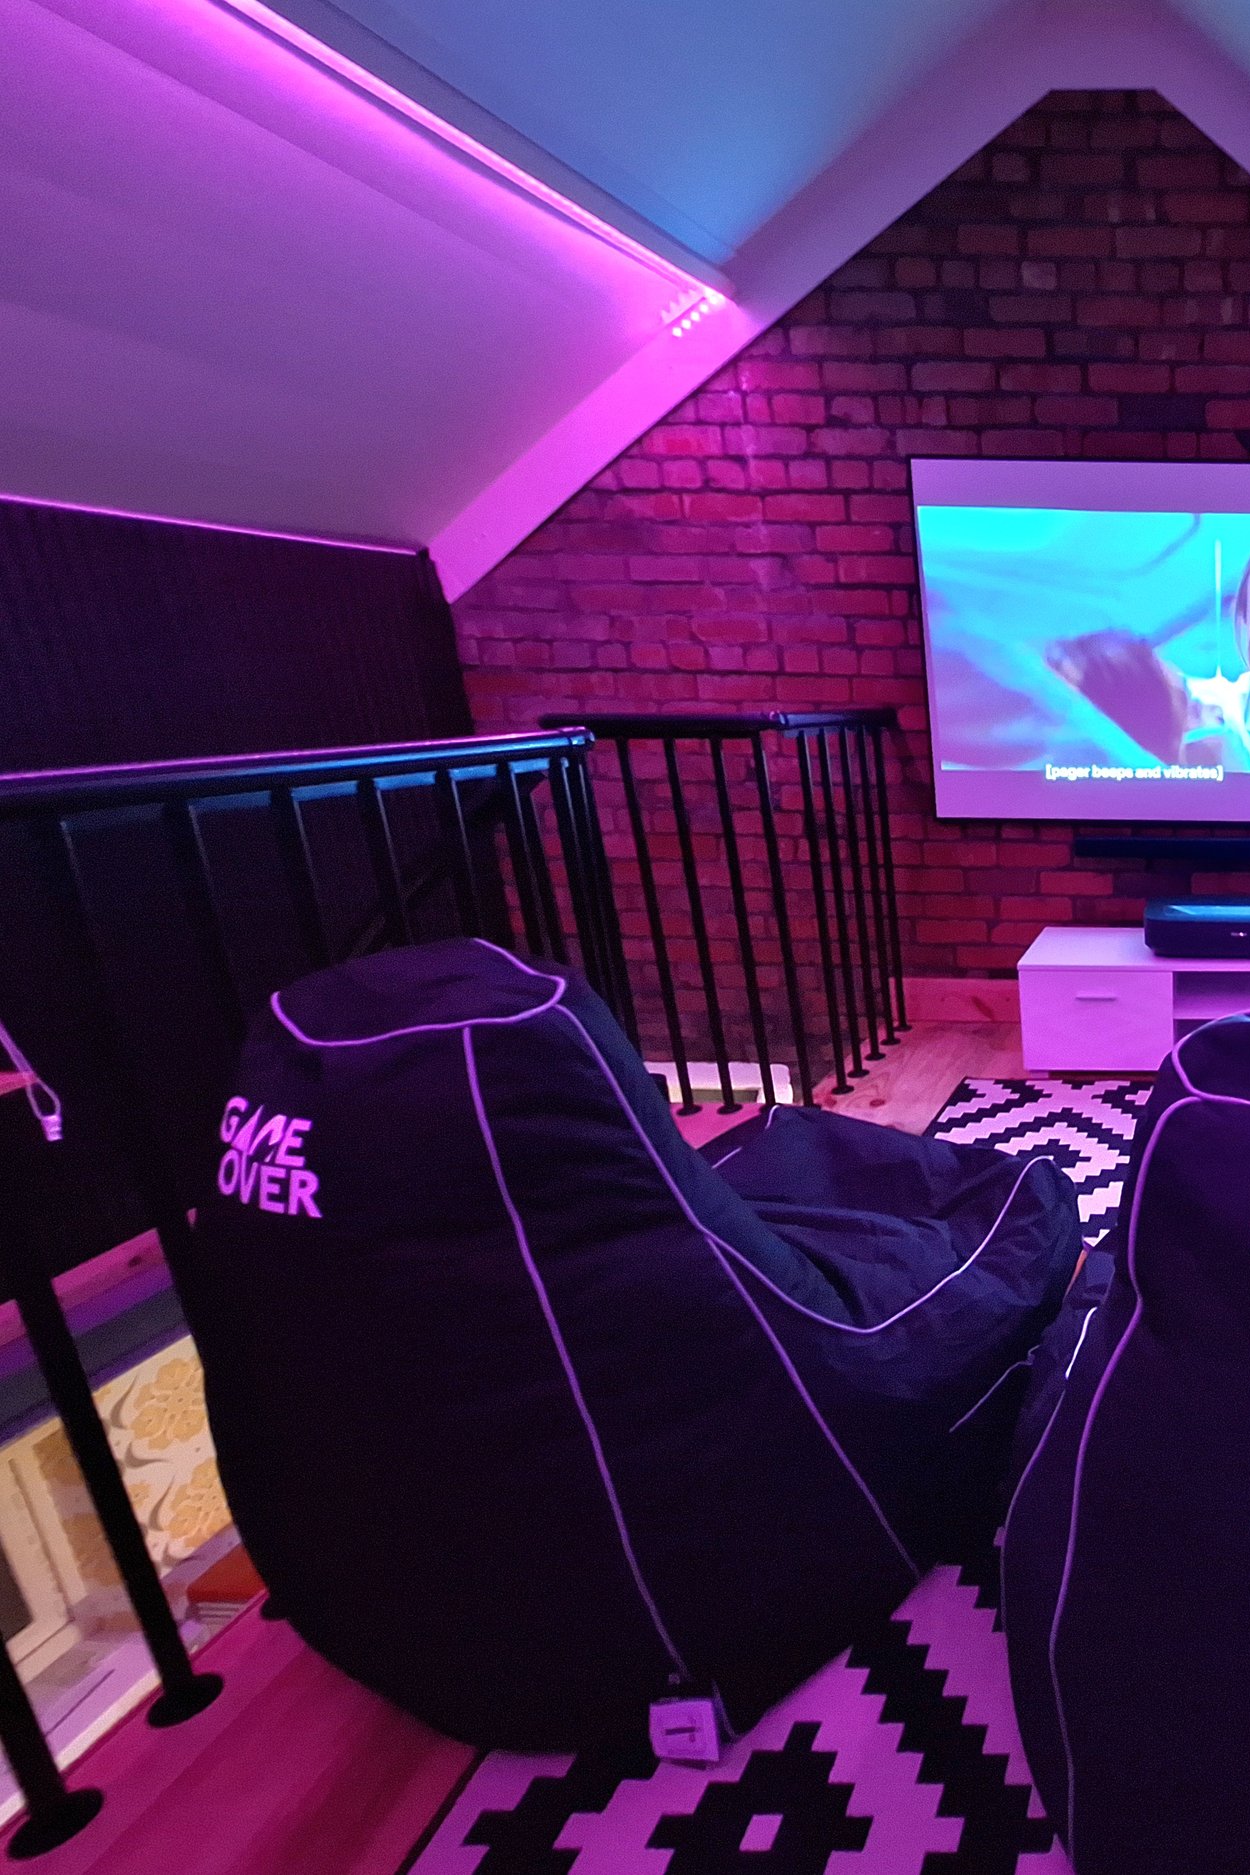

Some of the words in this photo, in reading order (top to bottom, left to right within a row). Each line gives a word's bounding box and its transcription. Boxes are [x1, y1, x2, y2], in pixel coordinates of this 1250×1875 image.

[1135, 765, 1161, 779] and
[220, 1096, 313, 1167] GAME
[218, 1149, 323, 1218] OVER
